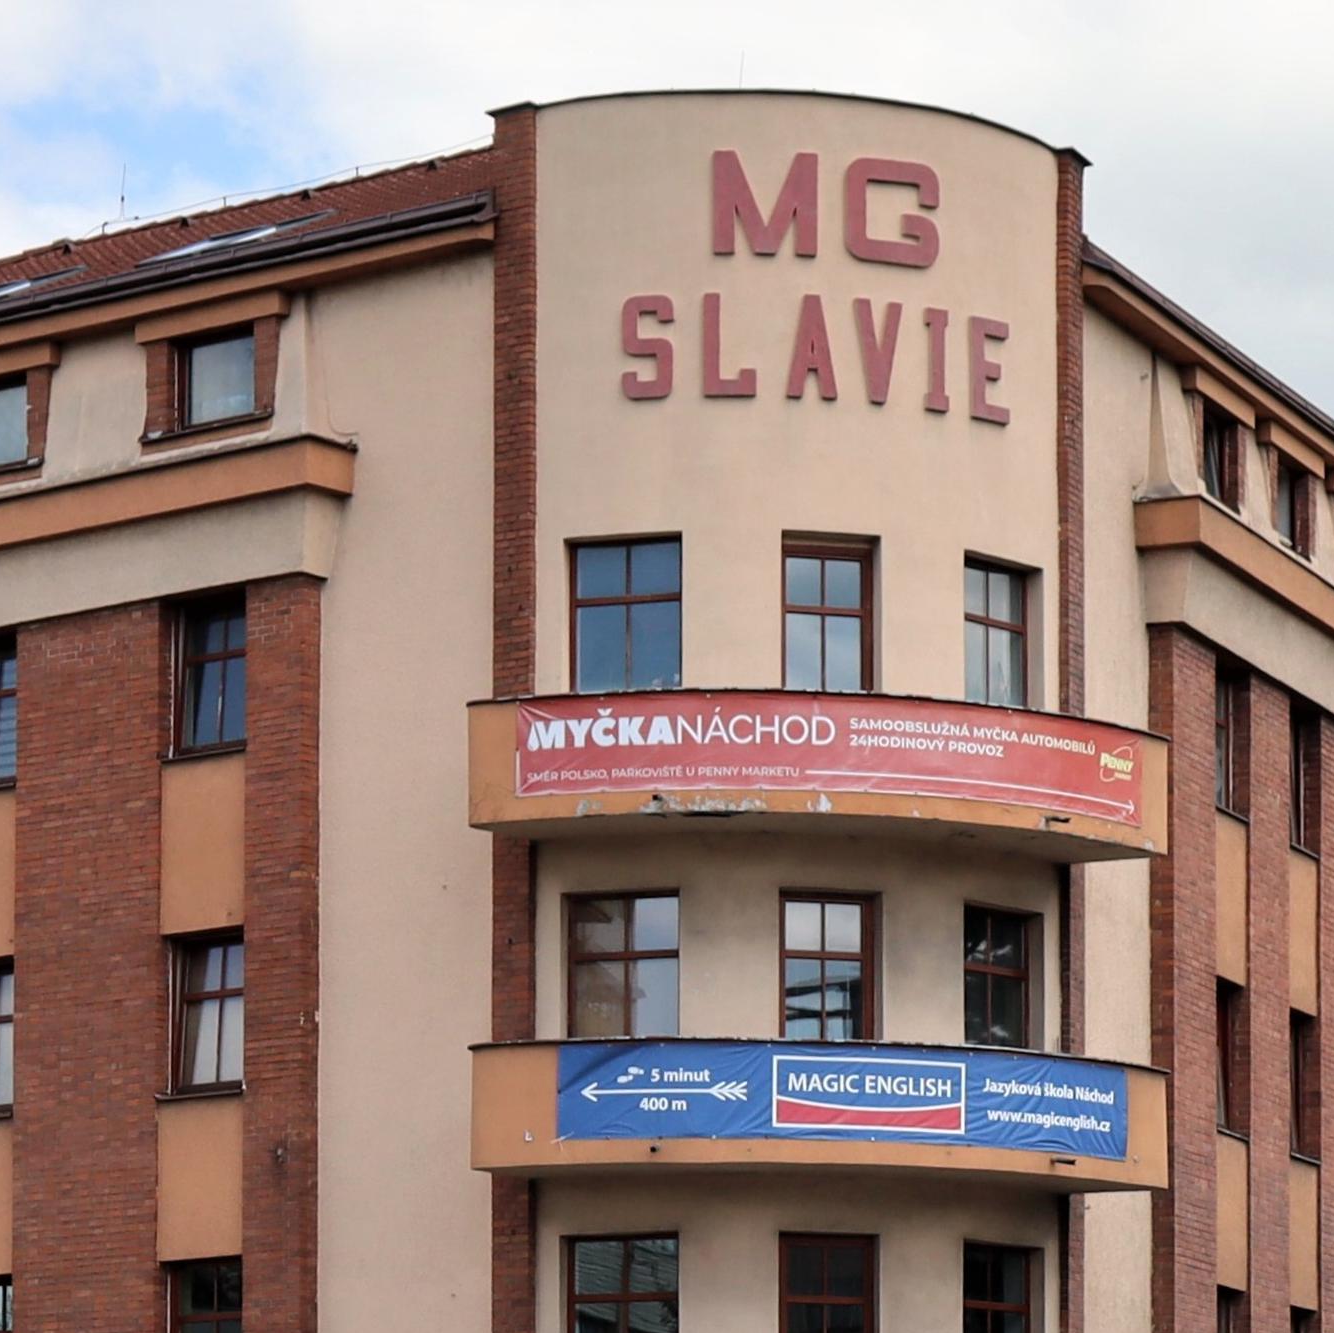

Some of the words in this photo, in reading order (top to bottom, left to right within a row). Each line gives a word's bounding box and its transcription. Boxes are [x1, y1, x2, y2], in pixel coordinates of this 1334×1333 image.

[711, 149, 940, 268] MG
[620, 291, 1012, 427] SLAVIE
[849, 716, 969, 738] SAMOOBSLUŽNÁ
[972, 725, 1019, 743] MYČKA
[1020, 732, 1096, 756] AUTOMOBILŮ
[849, 734, 945, 752] 24HODINOVÝ
[948, 739, 1004, 757] PROVOZ
[560, 768, 610, 782] POLSKO,
[611, 764, 683, 778] PARKOVIŠTĚ
[685, 766, 696, 778] U
[698, 766, 739, 778] PENNY
[742, 766, 800, 778] MARKETU
[1100, 752, 1134, 773] PENNY
[650, 1068, 660, 1082] 5
[663, 1067, 711, 1083] minut
[788, 1072, 859, 1094] MAGIC
[865, 1075, 952, 1098] ENGLISH
[639, 1097, 668, 1111] 400
[671, 1100, 687, 1111] m
[983, 1078, 1042, 1098] Jazyková
[1043, 1082, 1073, 1099] škola
[1075, 1087, 1115, 1105] Náchod
[987, 1108, 1112, 1133] www.magicenglish.cz
